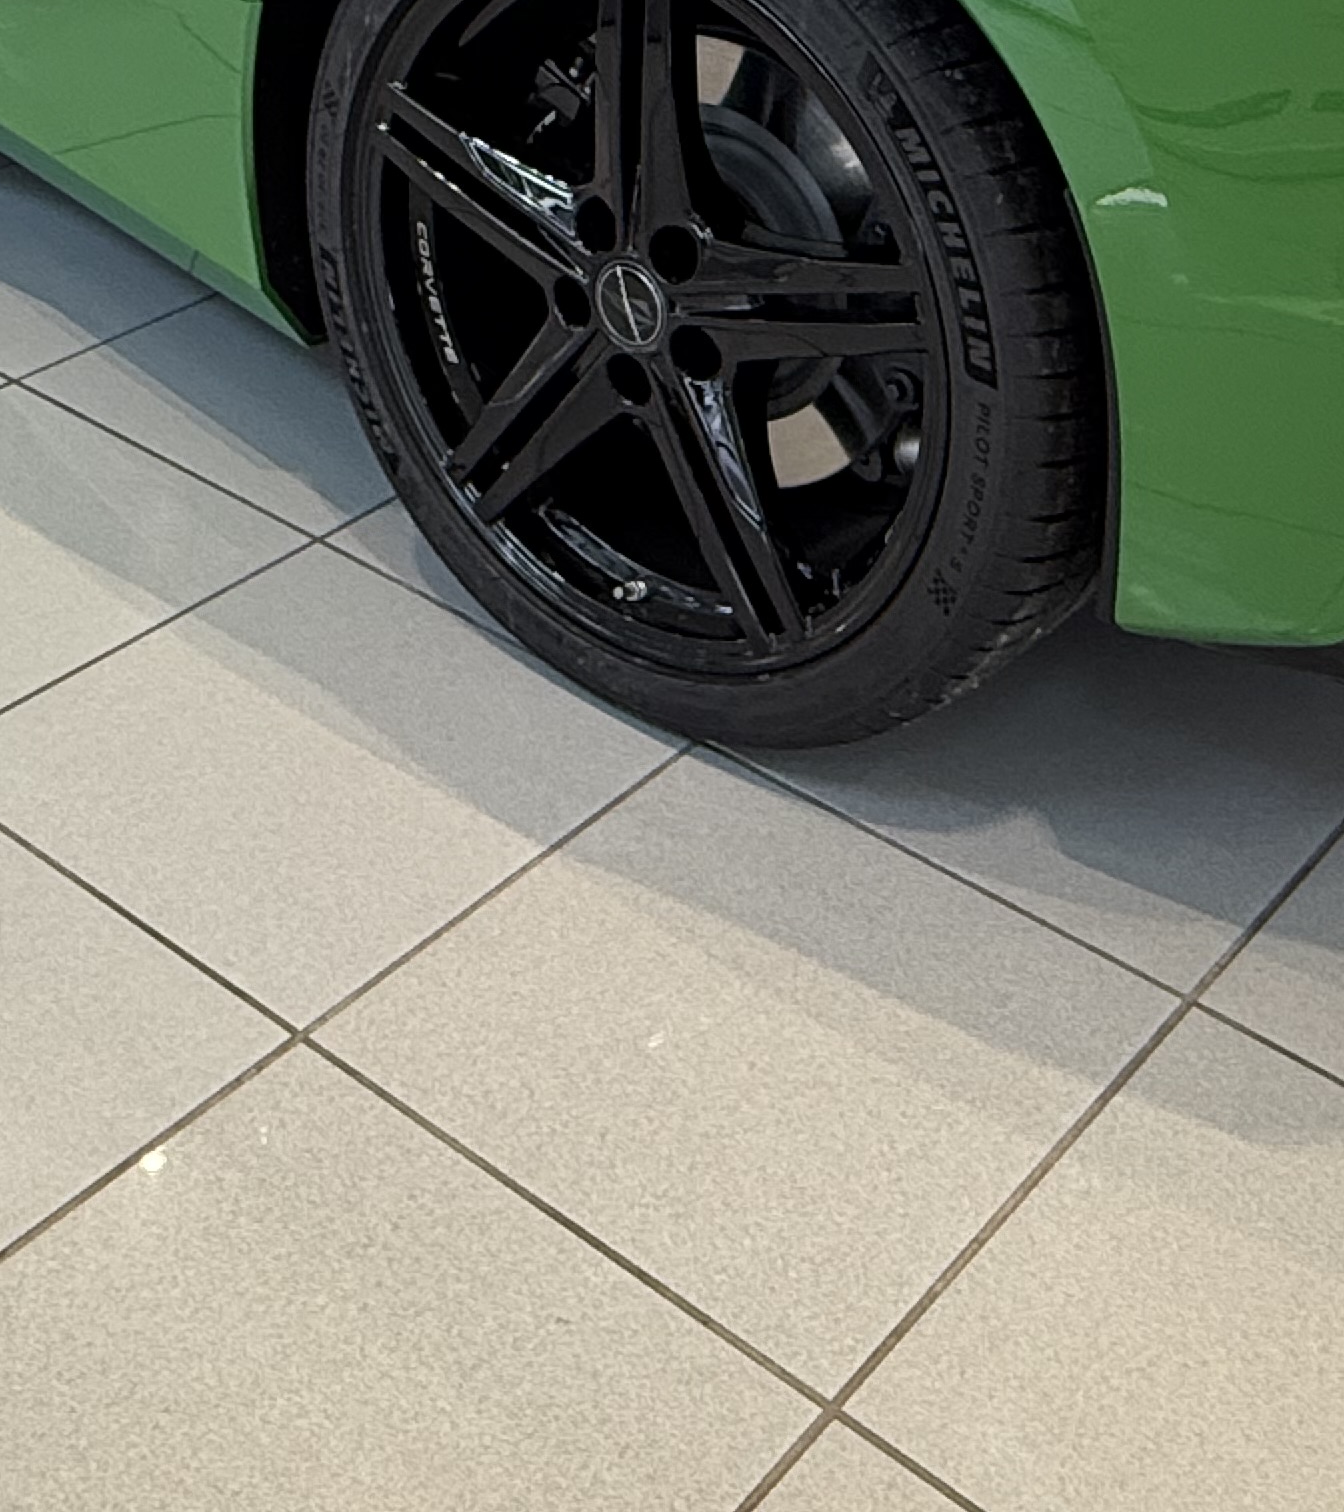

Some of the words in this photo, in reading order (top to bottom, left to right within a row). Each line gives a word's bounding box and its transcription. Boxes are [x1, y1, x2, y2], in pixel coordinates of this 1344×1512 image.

[416, 220, 460, 364] CORVETTE
[893, 126, 993, 372] MICHELIN
[973, 401, 992, 469] PILOT
[960, 472, 987, 545] SPORT
